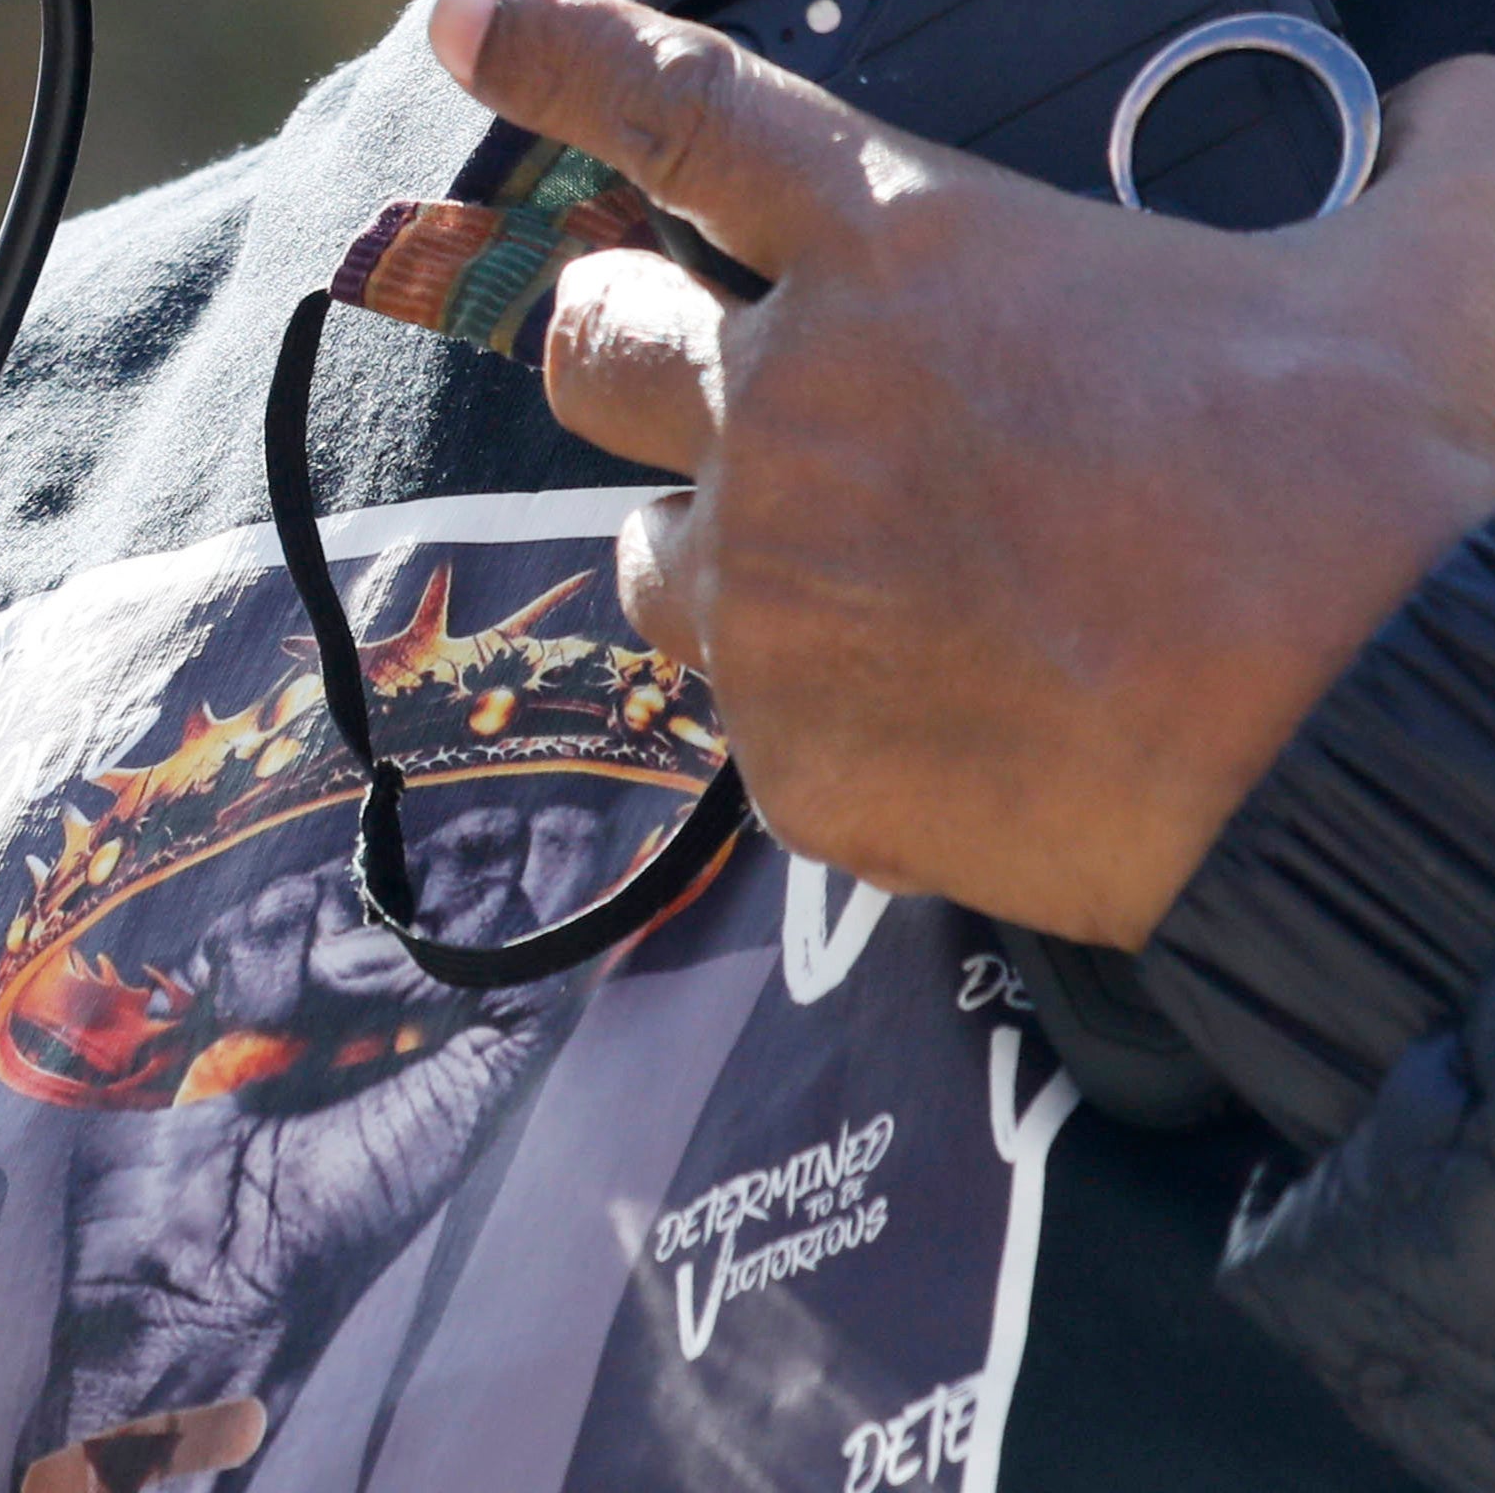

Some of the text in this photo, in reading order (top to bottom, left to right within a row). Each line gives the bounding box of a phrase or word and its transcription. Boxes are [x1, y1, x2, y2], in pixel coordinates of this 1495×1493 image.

[655, 1112, 895, 1262] DETERMINED
[803, 1175, 868, 1222] TO BE
